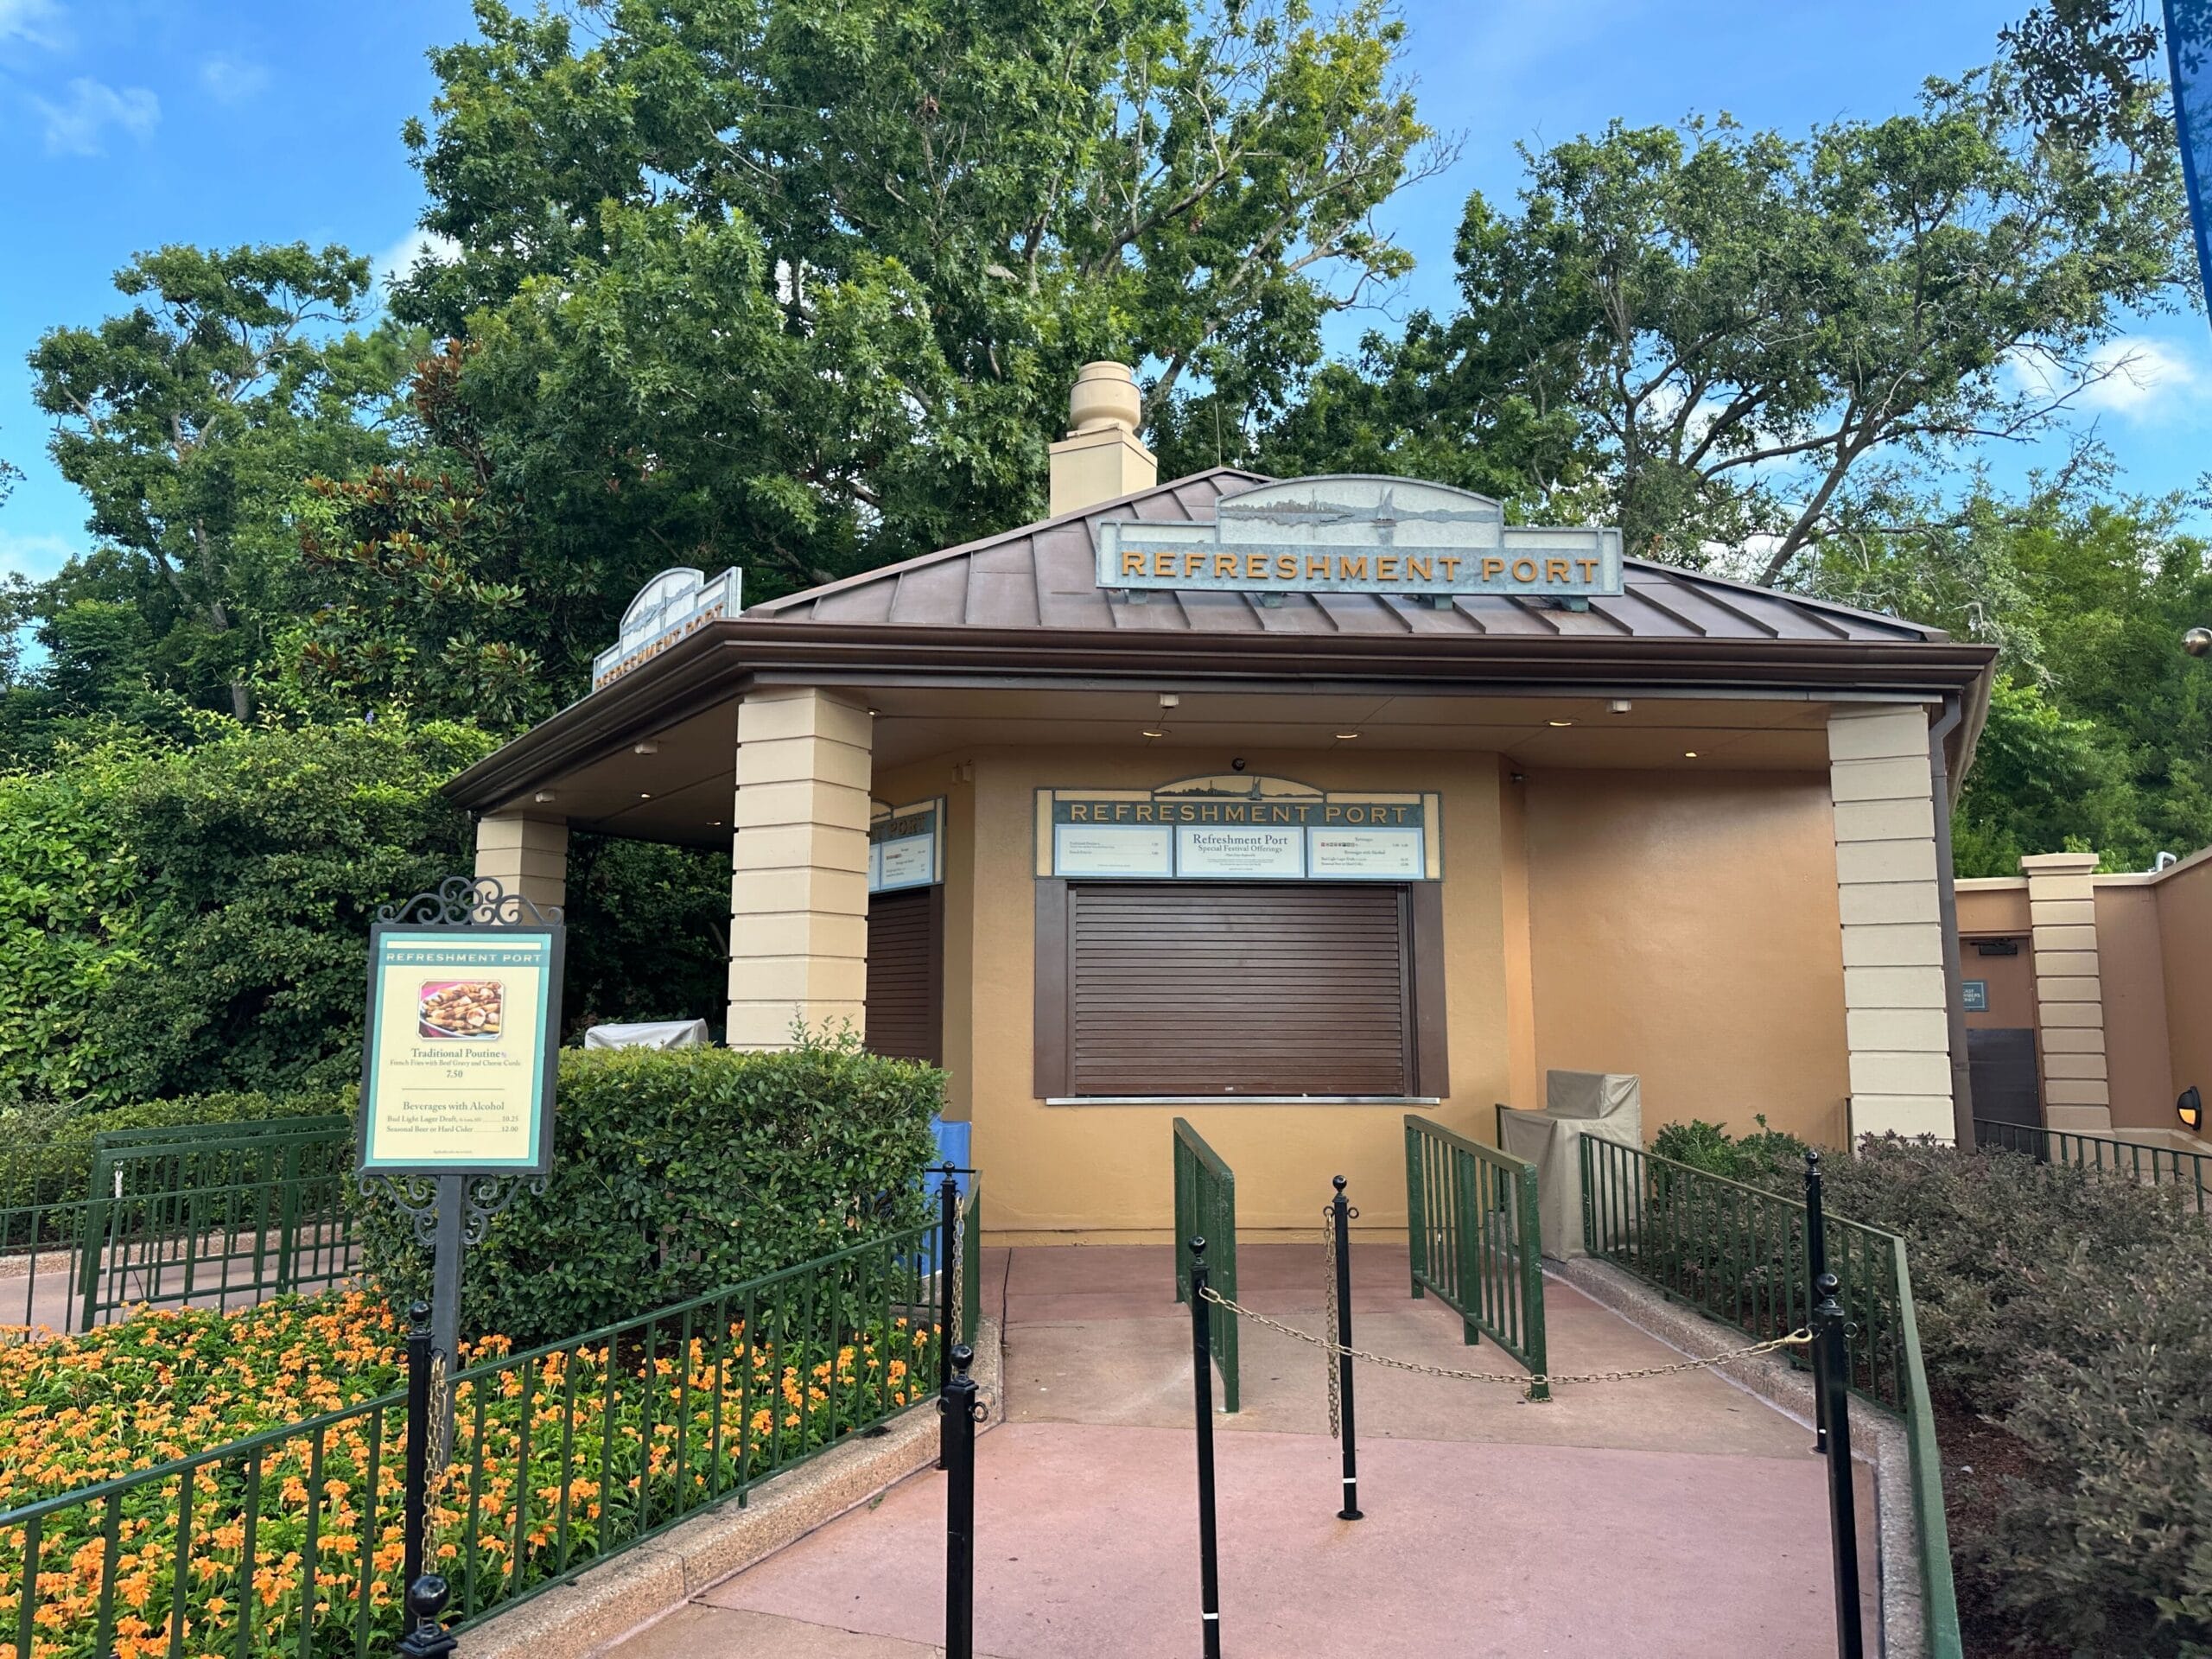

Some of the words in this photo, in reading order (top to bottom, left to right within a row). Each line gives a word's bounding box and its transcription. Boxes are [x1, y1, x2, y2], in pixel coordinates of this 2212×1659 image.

[1122, 550, 1461, 582] REFRESHMENT
[1481, 556, 1599, 583] PORT
[685, 601, 724, 634] PORT
[1070, 804, 1311, 823] REFRESHMENT
[1325, 807, 1408, 824] PORT
[1193, 834, 1262, 845] Refreshment
[1265, 834, 1287, 845] Port
[1198, 844, 1223, 854] Special
[1250, 845, 1282, 854] Offerings
[386, 953, 497, 962] REFRESHMENT
[502, 954, 542, 963] PORT
[411, 1048, 462, 1058] Traditional
[465, 1048, 501, 1058] Poutine
[446, 1070, 463, 1078] 7.50
[403, 1102, 447, 1111] Beverages
[448, 1102, 467, 1110] with
[469, 1102, 505, 1110] Alcohol
